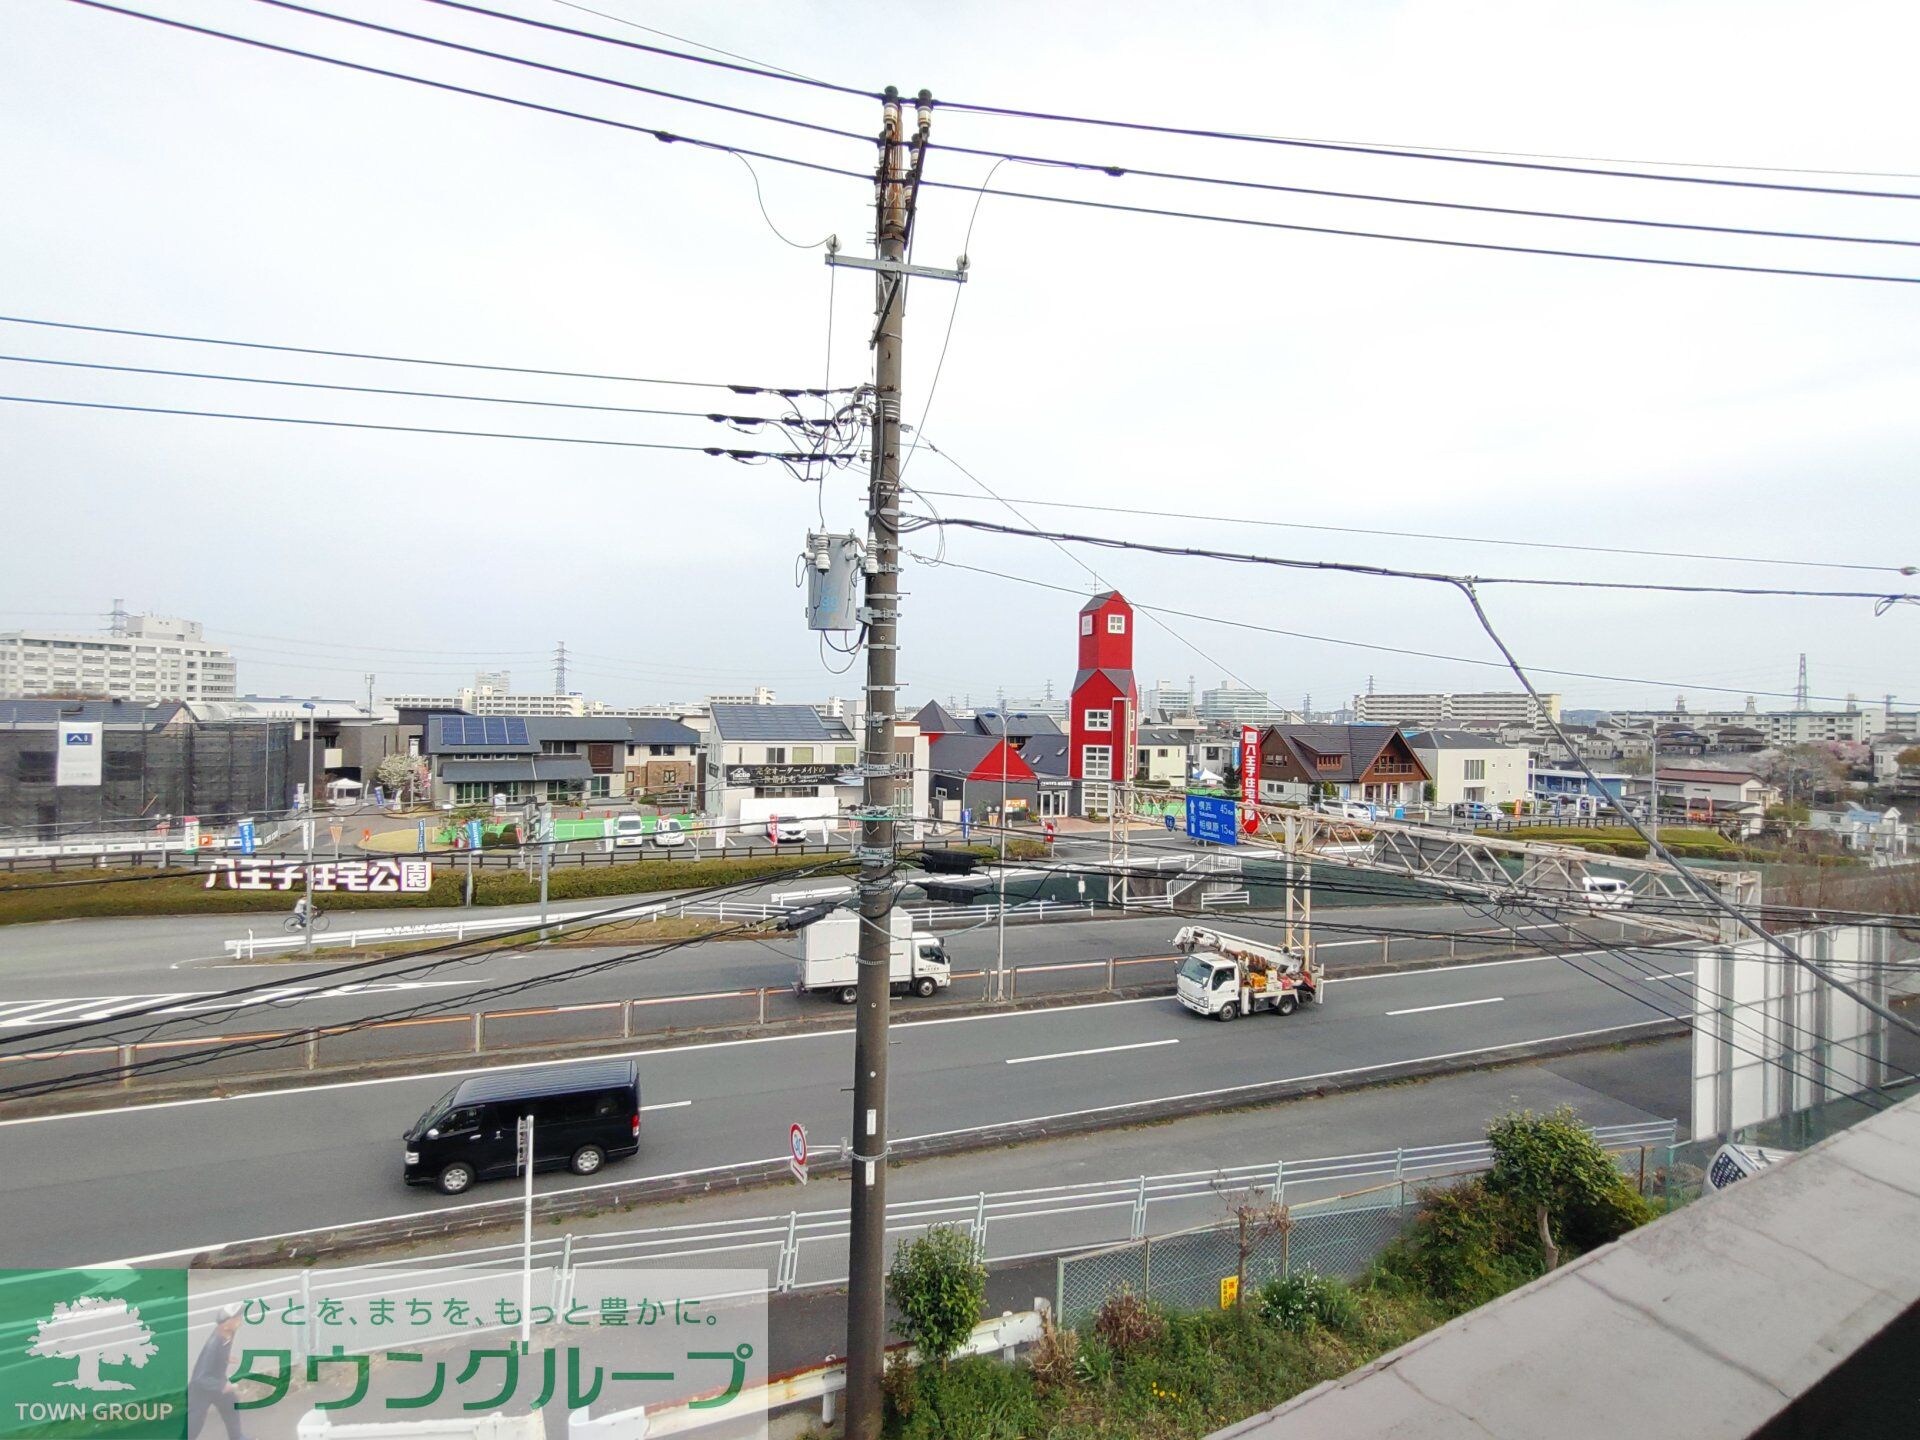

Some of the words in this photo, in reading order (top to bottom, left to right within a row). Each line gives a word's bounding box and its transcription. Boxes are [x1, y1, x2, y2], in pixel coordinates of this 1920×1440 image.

[1198, 801, 1212, 811] 横浜
[1199, 820, 1219, 832] 相模原
[205, 858, 433, 892] 八王子住宅公園
[793, 1133, 802, 1156] 30
